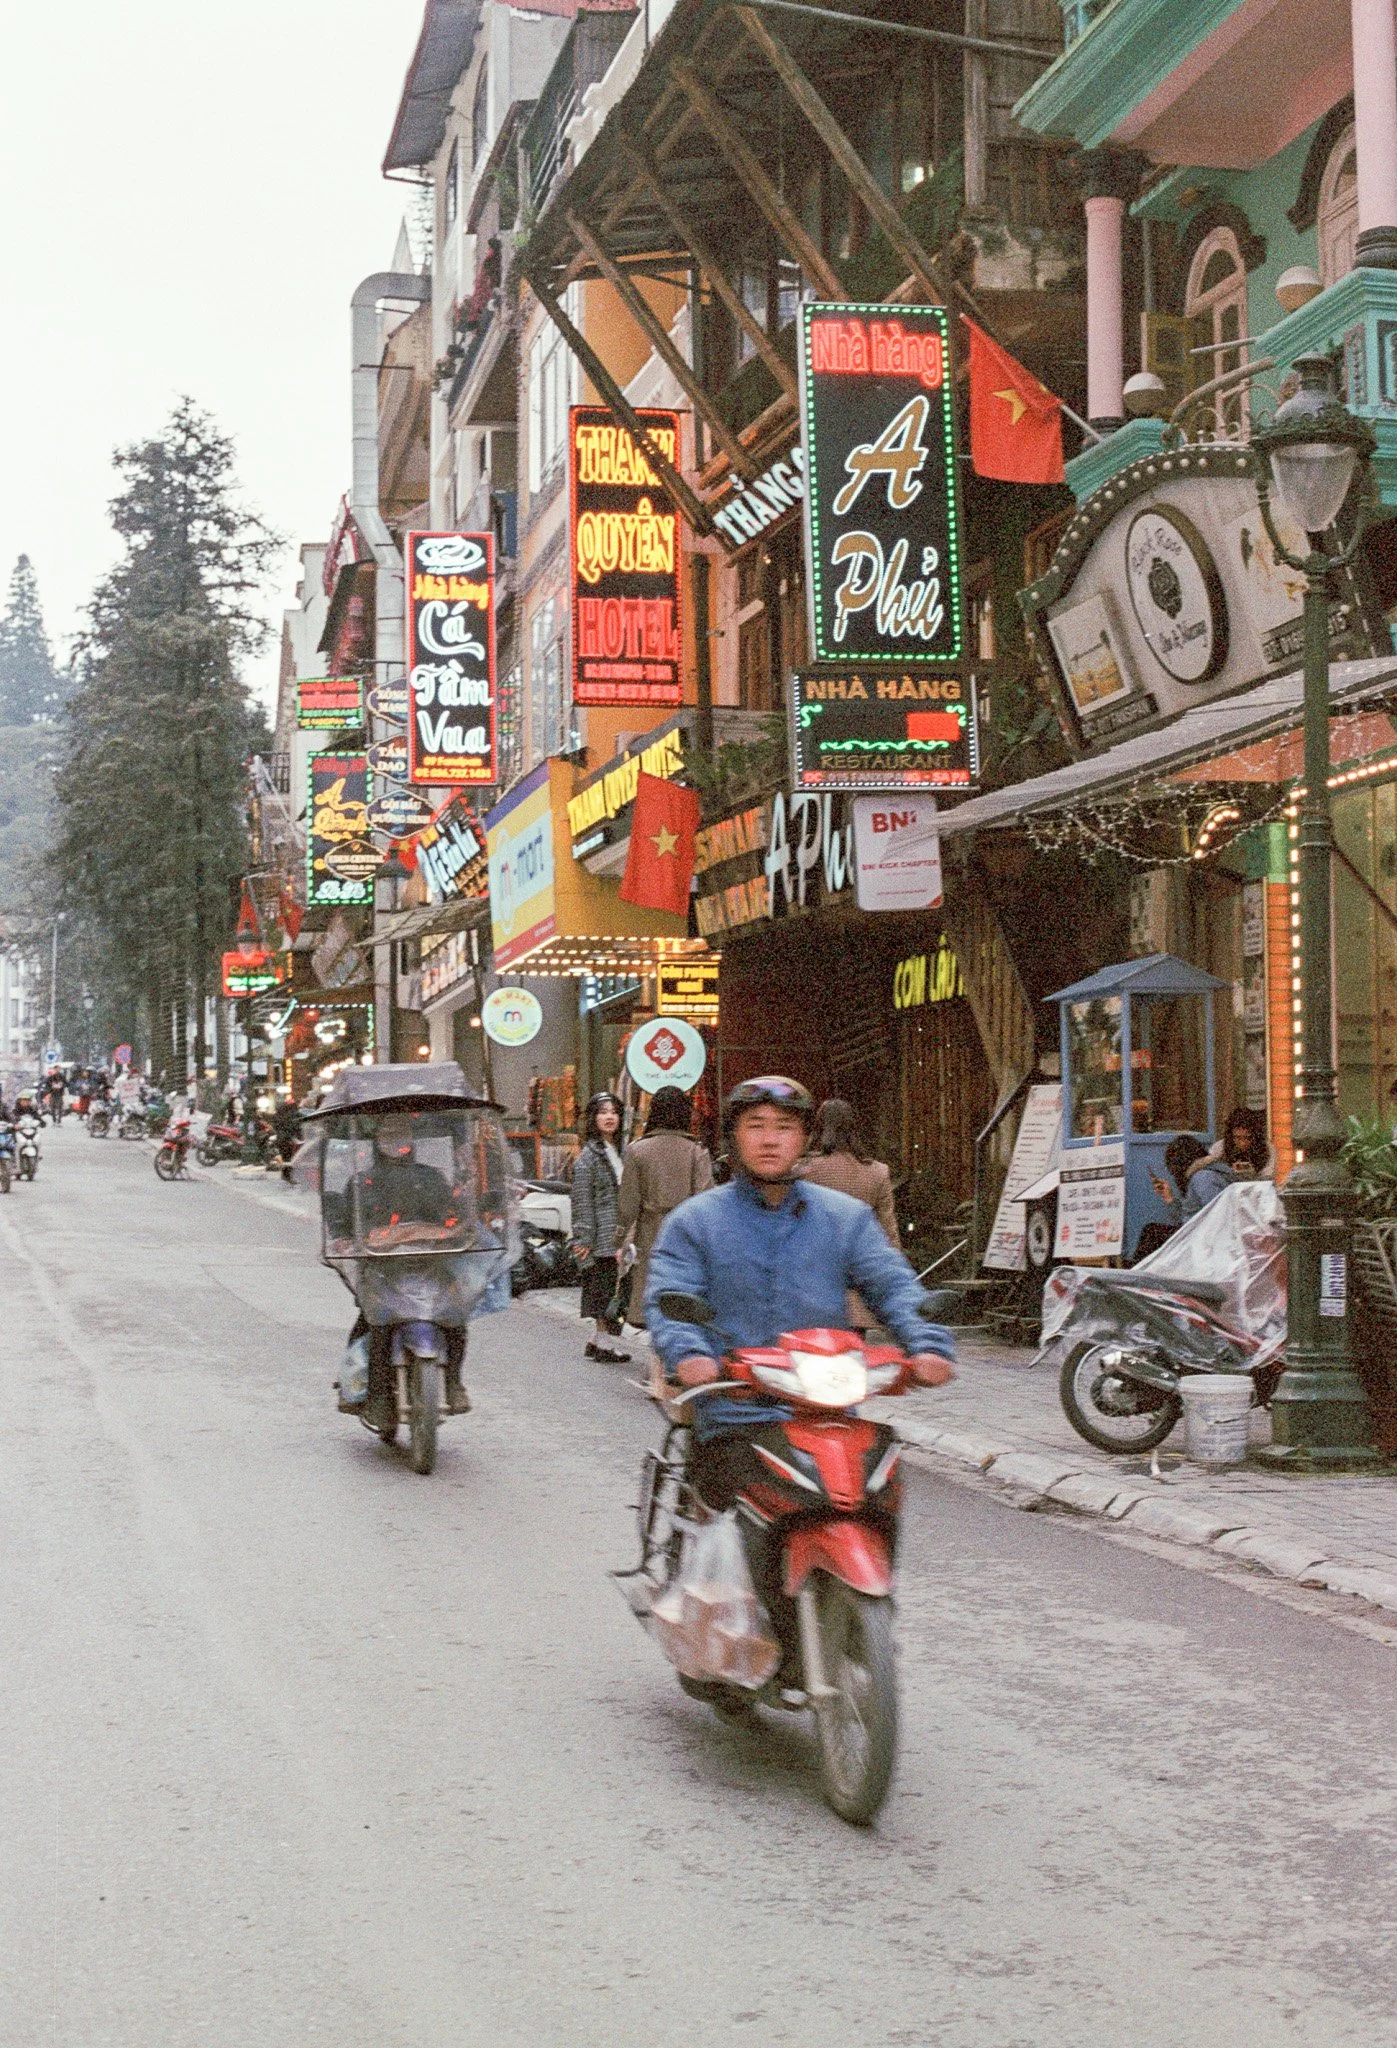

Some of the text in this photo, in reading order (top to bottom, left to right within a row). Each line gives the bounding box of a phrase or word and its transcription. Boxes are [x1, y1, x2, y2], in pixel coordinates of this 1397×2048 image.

[813, 321, 943, 387] Nhà hàng
[833, 395, 930, 516] A
[577, 497, 675, 584] QUYÊN
[831, 530, 945, 643] Phủ
[418, 600, 485, 662] Cá
[577, 595, 680, 661] HOTEL
[410, 659, 495, 707] Tầm
[806, 675, 962, 700] NHÀ HÀNG
[416, 710, 492, 754] Vua
[821, 754, 952, 769] RESTAURANT
[790, 793, 855, 907] Ph
